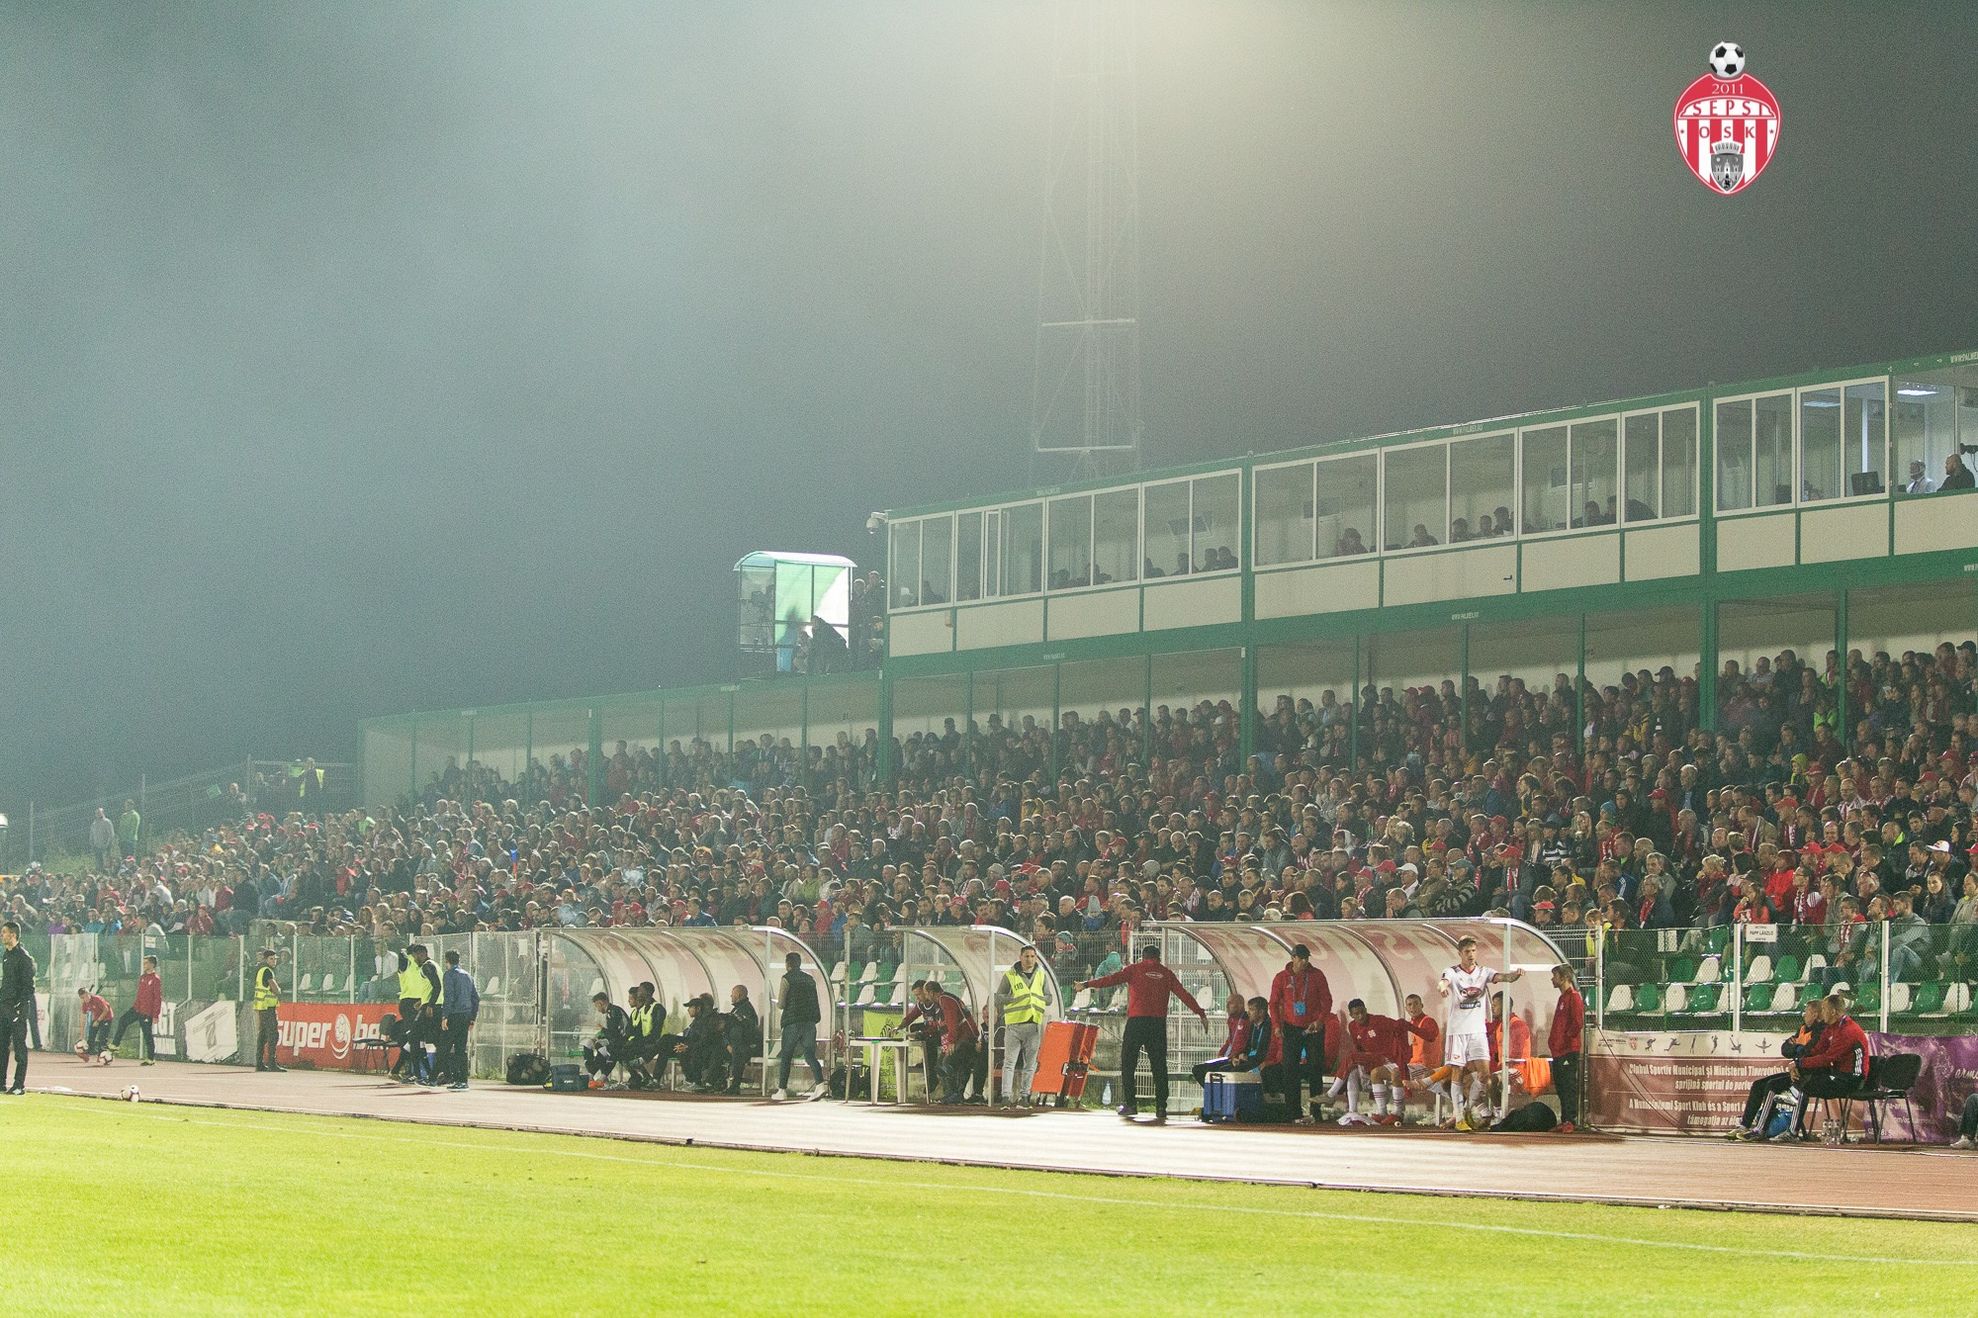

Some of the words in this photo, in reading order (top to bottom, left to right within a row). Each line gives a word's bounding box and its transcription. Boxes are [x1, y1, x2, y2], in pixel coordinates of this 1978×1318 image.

[1649, 1064, 1672, 1076] Sportiv
[1672, 1065, 1705, 1077] Municipal
[1713, 1065, 1747, 1077] Ministerul
[1701, 1079, 1724, 1091] sportul
[1725, 1080, 1734, 1090] de
[1674, 1100, 1692, 1112] Sport
[1722, 1101, 1741, 1113] Sport
